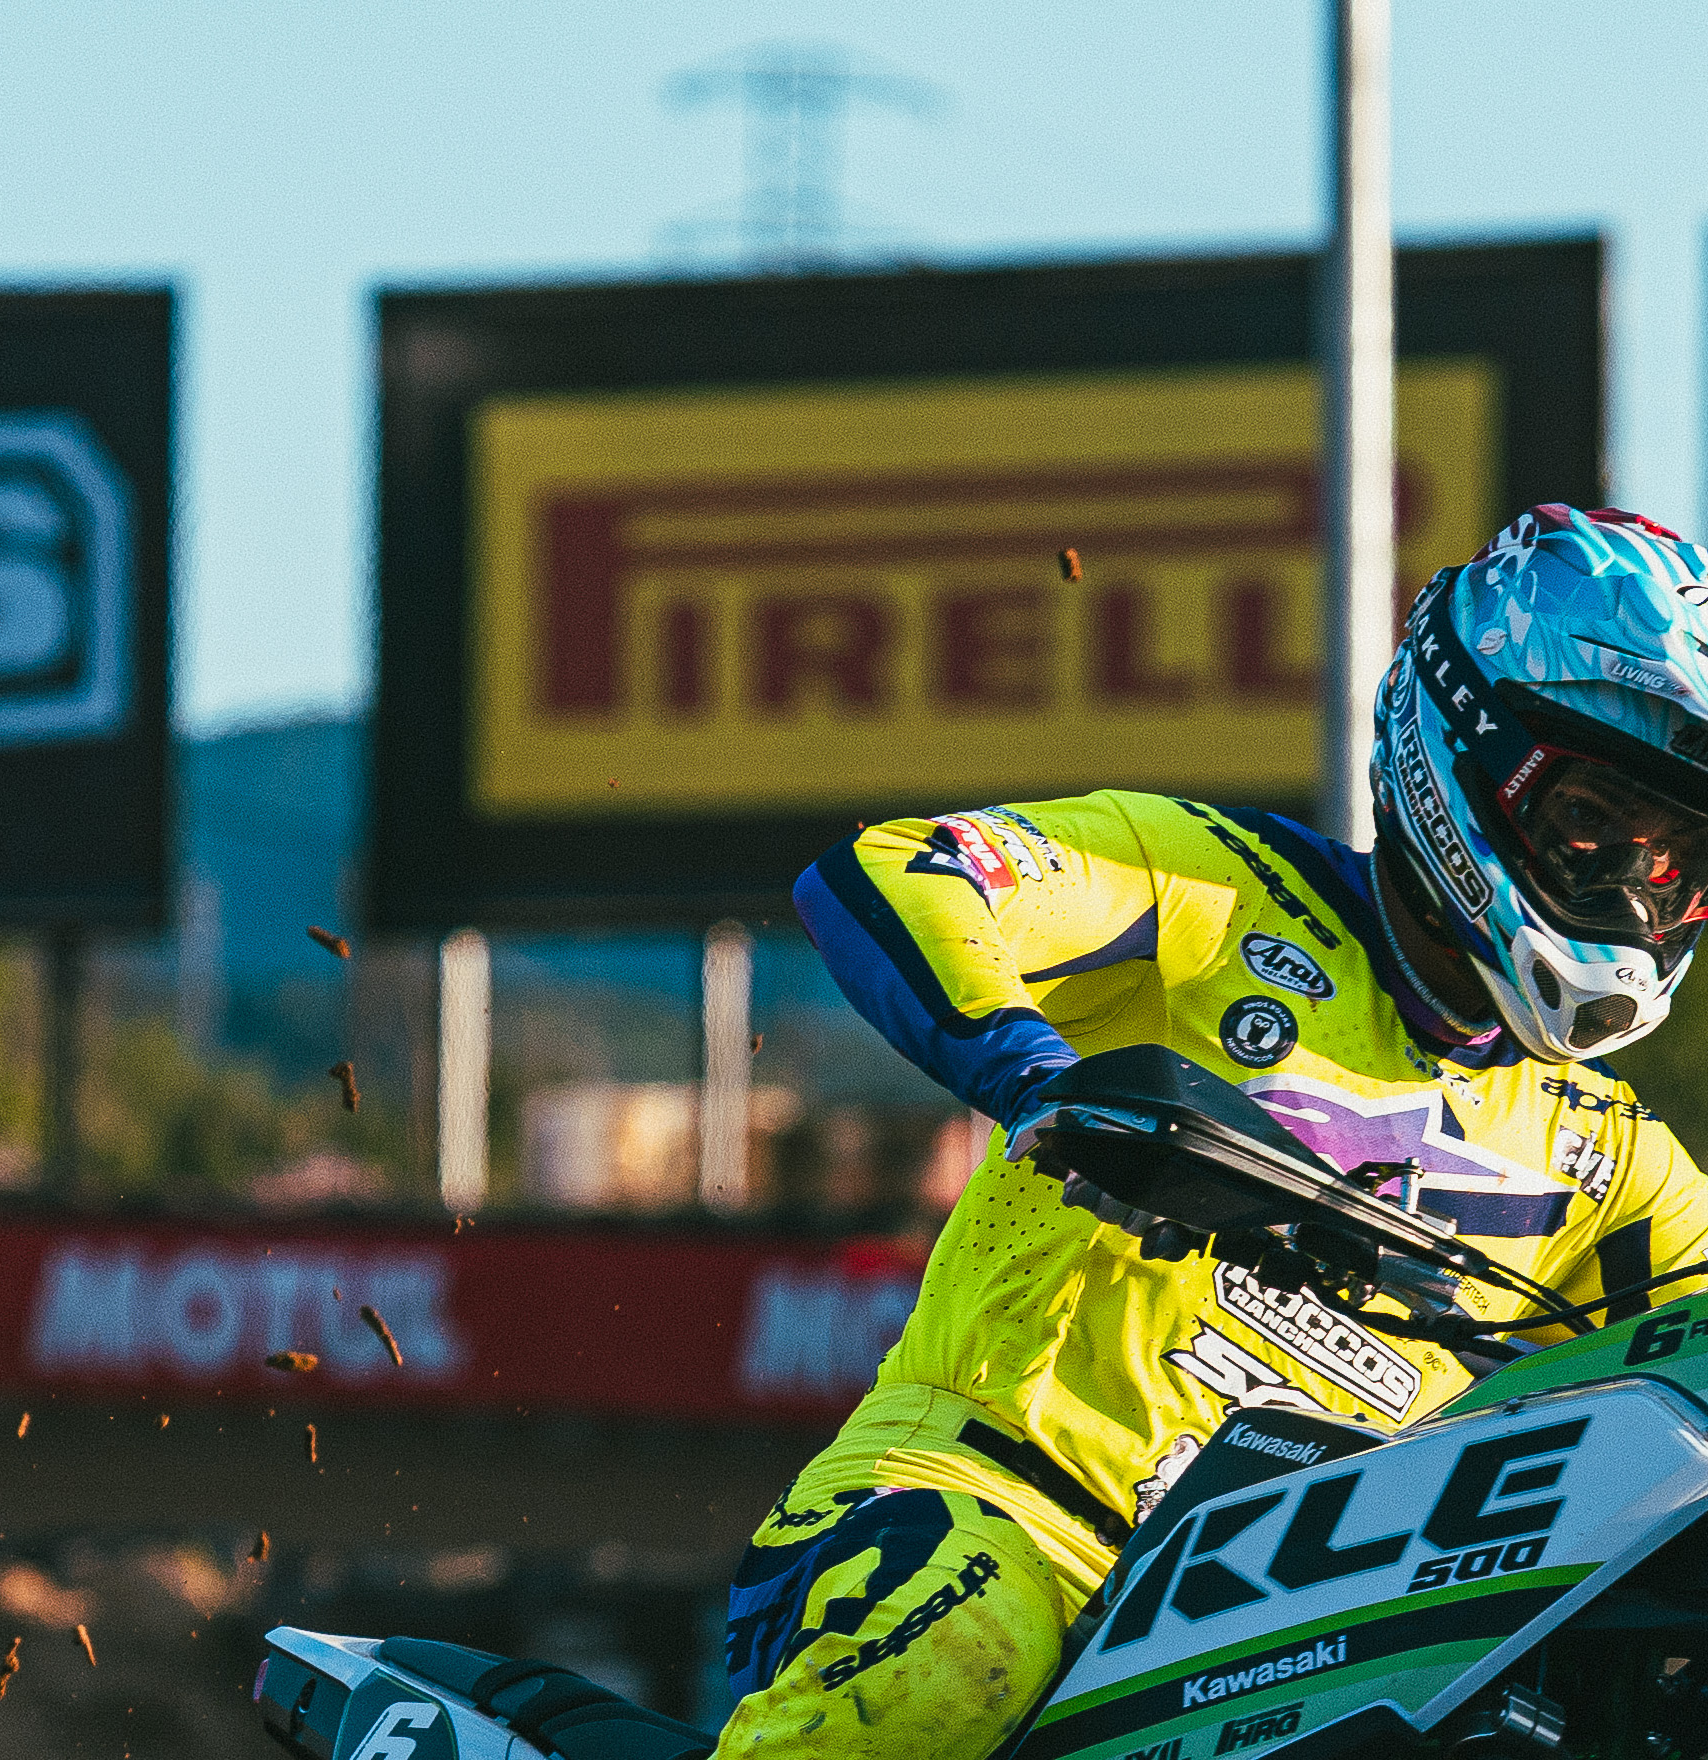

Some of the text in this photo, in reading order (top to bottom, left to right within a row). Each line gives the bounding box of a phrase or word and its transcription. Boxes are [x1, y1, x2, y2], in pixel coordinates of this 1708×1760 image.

[534, 452, 1431, 722] PIRELL
[1417, 613, 1498, 735] AKLEY
[1611, 662, 1670, 690] LIVING
[1503, 749, 1545, 799] OAKLEY
[1247, 943, 1325, 992] Arai
[29, 1245, 467, 1382] MOTUL
[1227, 1285, 1315, 1354] RANCH
[1623, 1309, 1691, 1366] 6
[1223, 1422, 1329, 1467] Kawasaki
[1101, 1416, 1591, 1654] KLE
[1406, 1535, 1551, 1595] 500
[1182, 1635, 1348, 1708] Kawasaki
